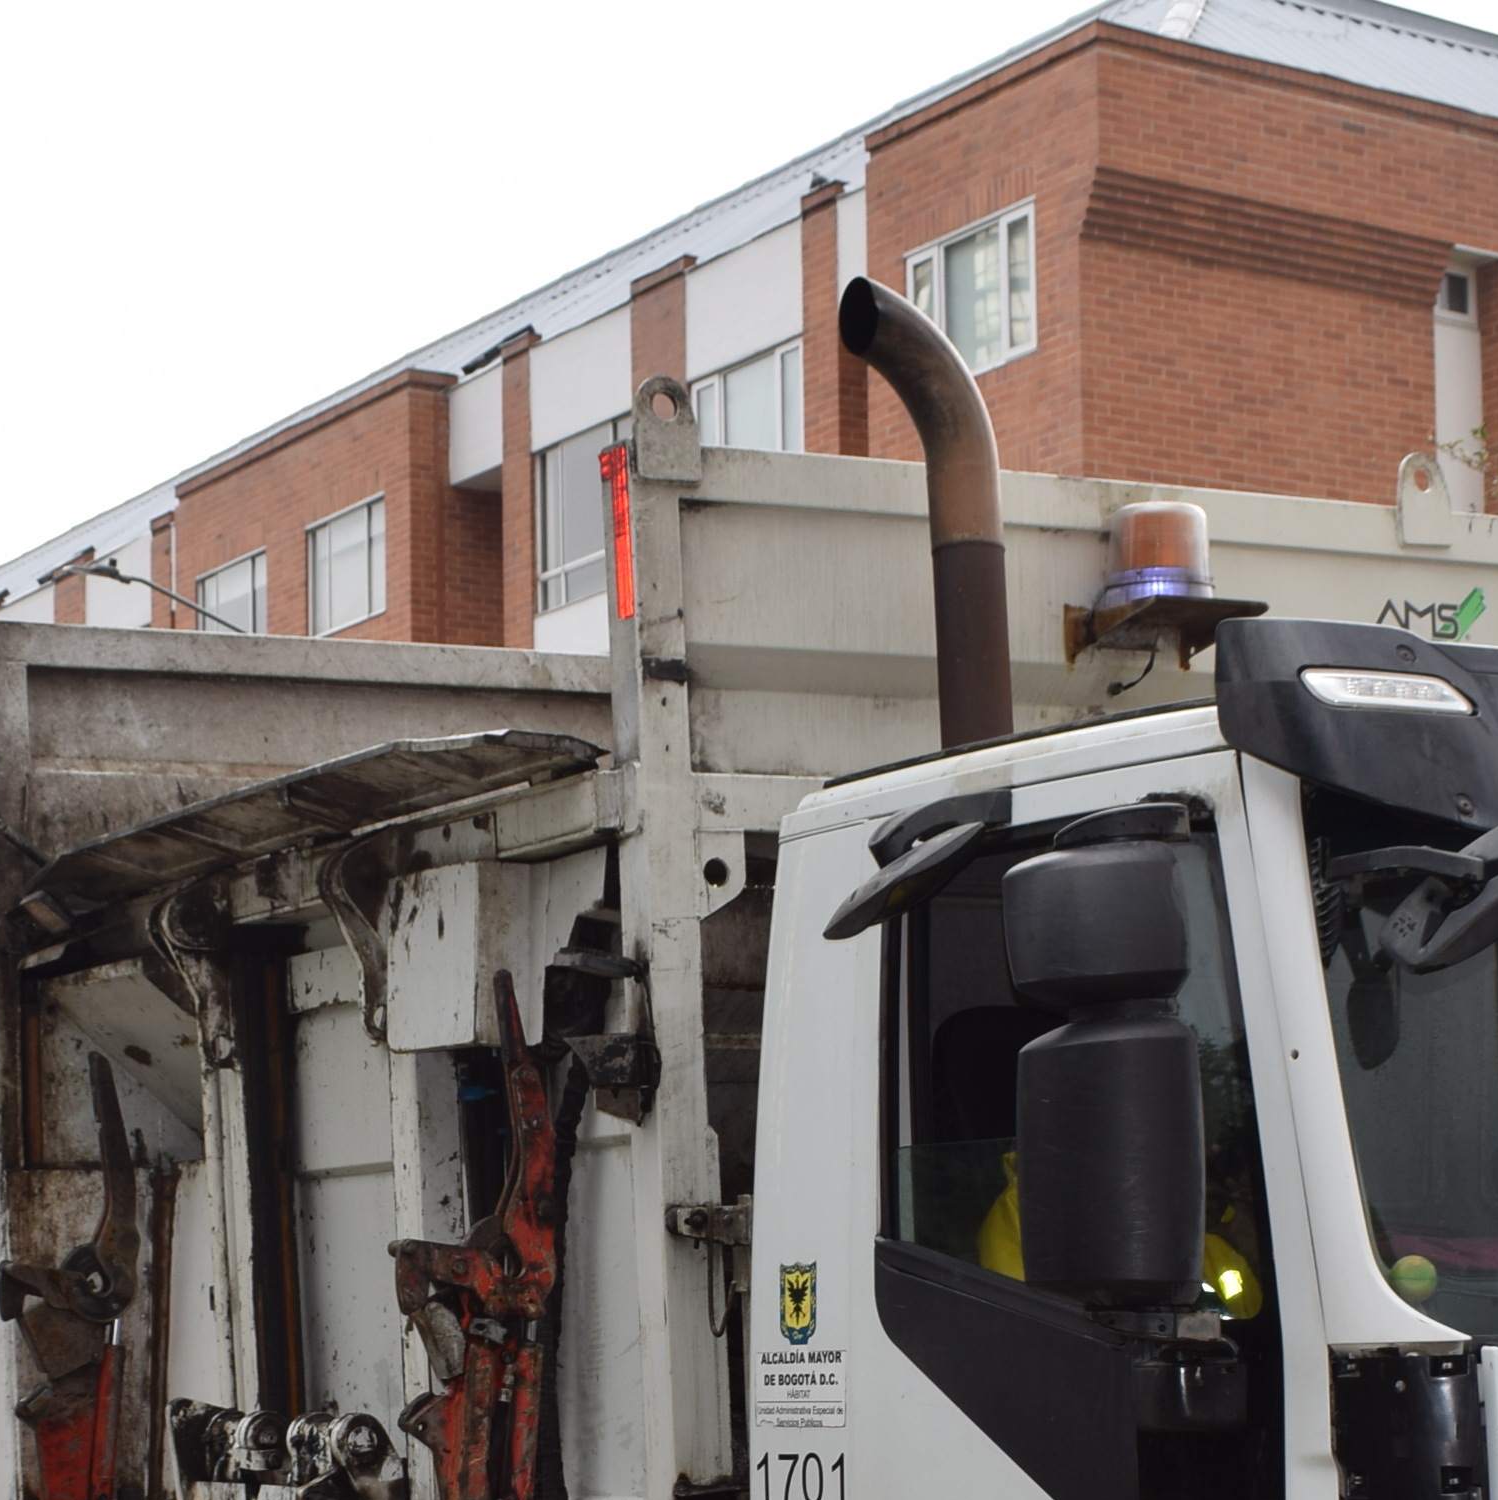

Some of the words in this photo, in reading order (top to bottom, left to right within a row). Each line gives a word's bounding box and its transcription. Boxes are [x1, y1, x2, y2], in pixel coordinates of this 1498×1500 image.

[1376, 598, 1459, 640] AMS
[761, 1349, 806, 1364] ALCALDÍA
[808, 1351, 842, 1364] MAYOR
[764, 1374, 776, 1386] DE
[778, 1370, 818, 1386] BOGOTÁ
[819, 1373, 839, 1386] D.C.
